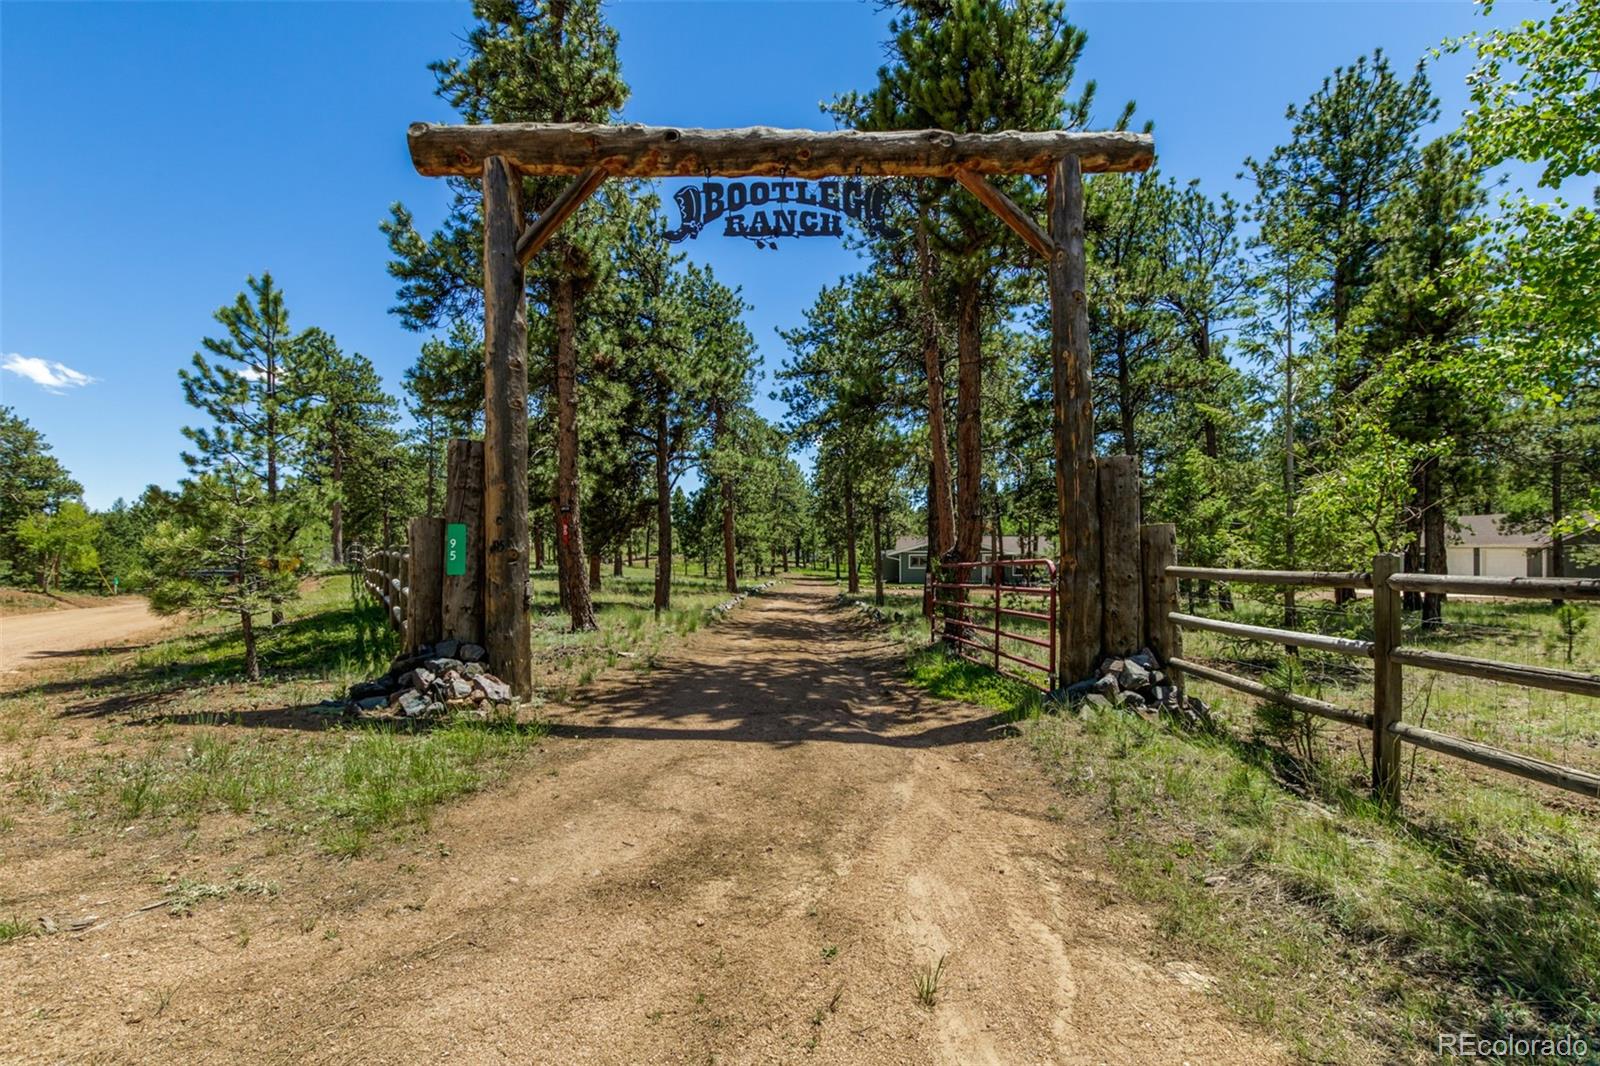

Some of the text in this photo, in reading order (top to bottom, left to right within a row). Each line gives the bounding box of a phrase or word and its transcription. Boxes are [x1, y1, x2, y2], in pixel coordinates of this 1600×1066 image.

[702, 181, 863, 224] BOOTLEG
[723, 210, 844, 237] RANCH
[449, 538, 457, 561] 95
